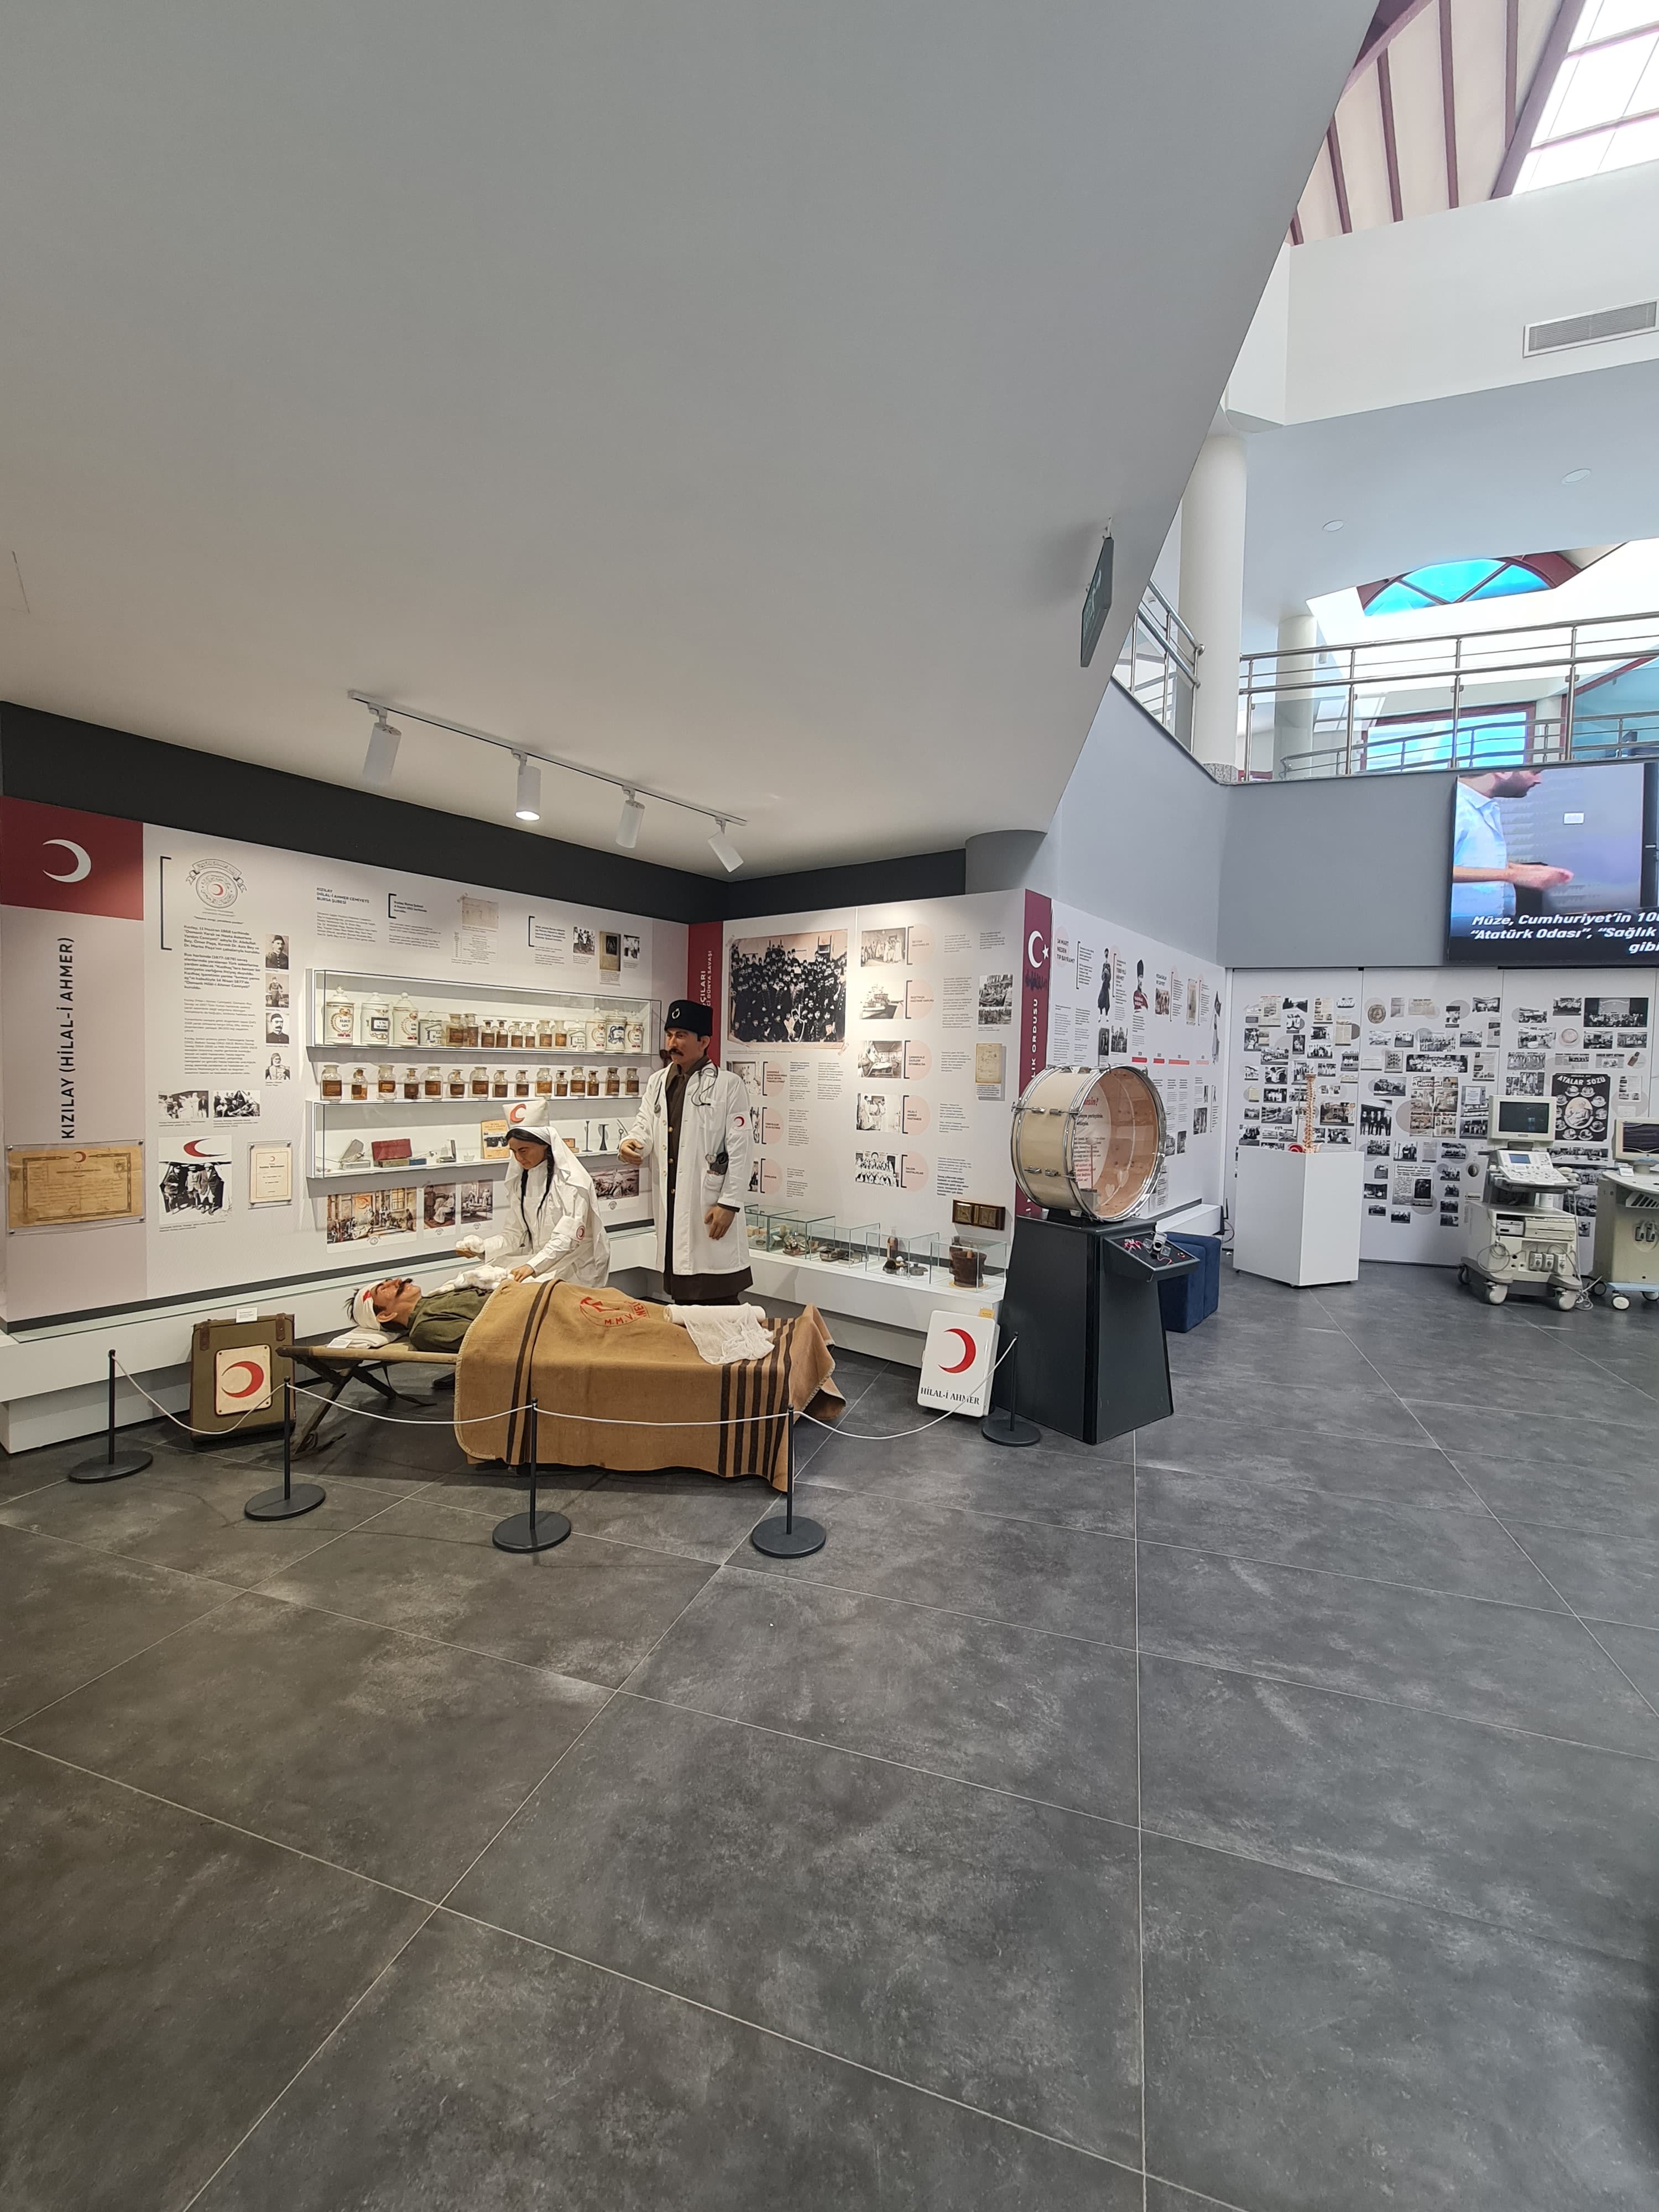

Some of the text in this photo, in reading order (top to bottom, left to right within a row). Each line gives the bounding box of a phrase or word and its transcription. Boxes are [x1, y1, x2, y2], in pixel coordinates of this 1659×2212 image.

[1472, 915, 1514, 926] Müze,
[56, 937, 75, 1139] KIZILAY (HİLAL-İ AHMER)
[1557, 1075, 1584, 1086] ATALAR
[921, 1386, 979, 1405] HİLAL-İ AHMER
